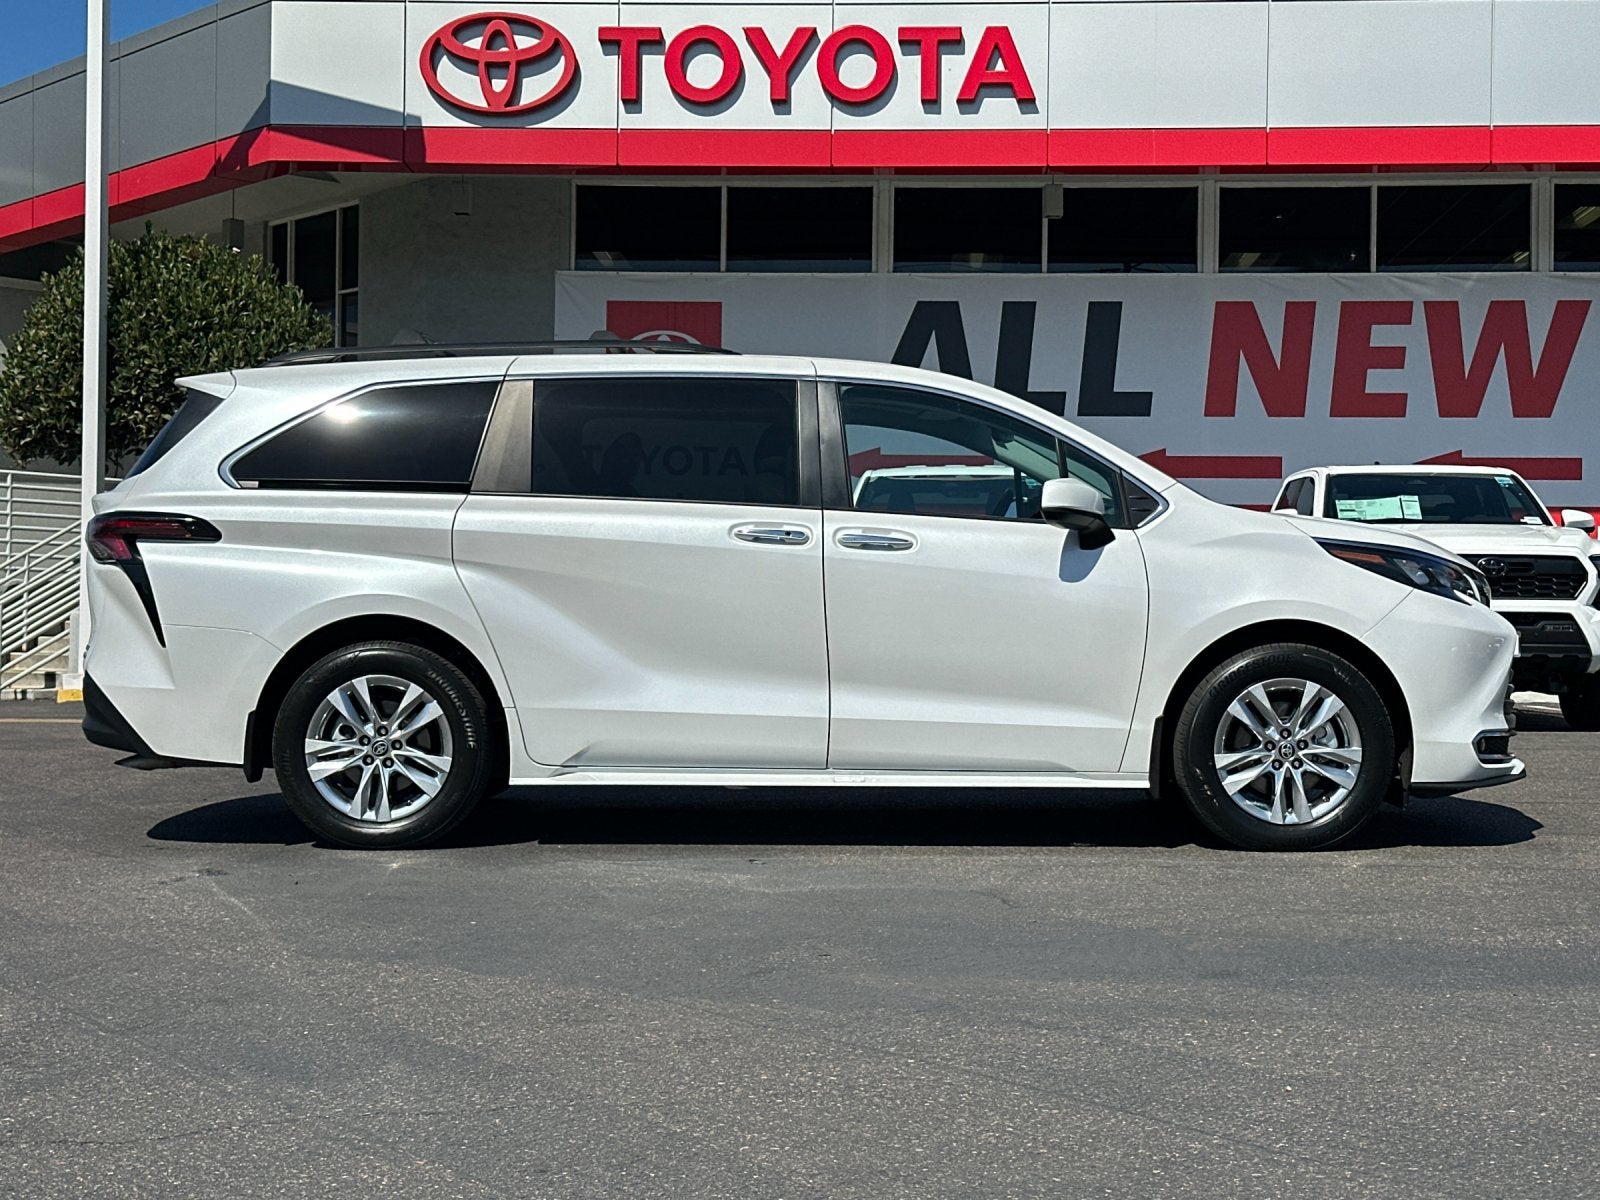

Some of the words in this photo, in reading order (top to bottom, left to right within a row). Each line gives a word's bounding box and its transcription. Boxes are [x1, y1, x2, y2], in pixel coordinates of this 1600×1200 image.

[598, 24, 1036, 103] TOYOTA
[889, 300, 1154, 417] ALL
[1203, 300, 1593, 418] NEW
